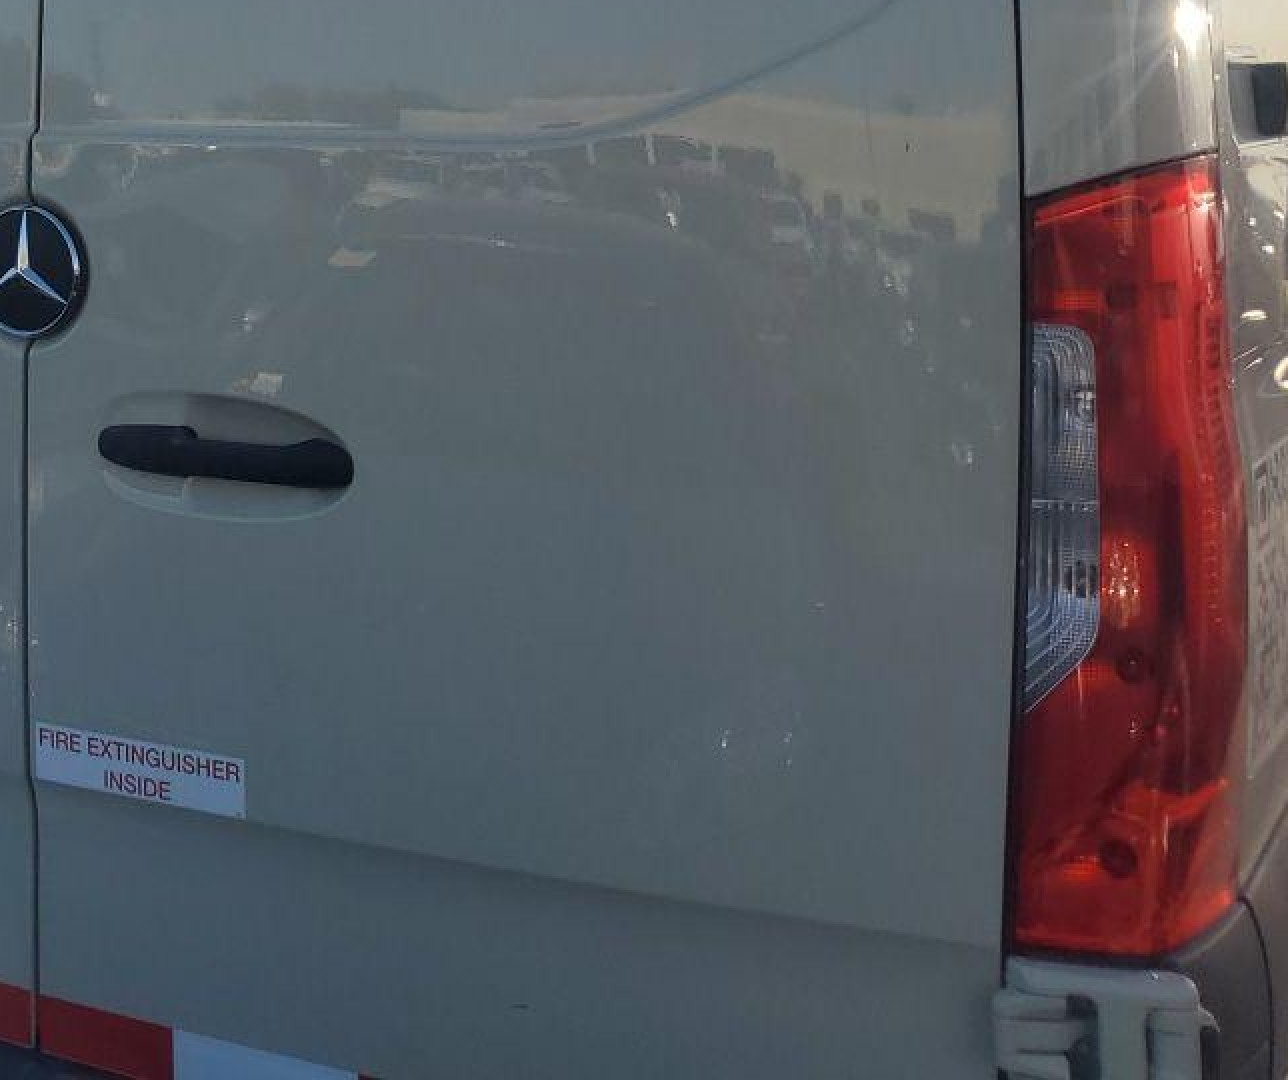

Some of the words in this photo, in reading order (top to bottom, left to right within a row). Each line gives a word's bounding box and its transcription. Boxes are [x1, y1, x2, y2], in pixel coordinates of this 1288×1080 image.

[39, 727, 82, 754] FIRE
[87, 736, 241, 782] EXTINGUISHER
[103, 770, 172, 801] INSIDE
